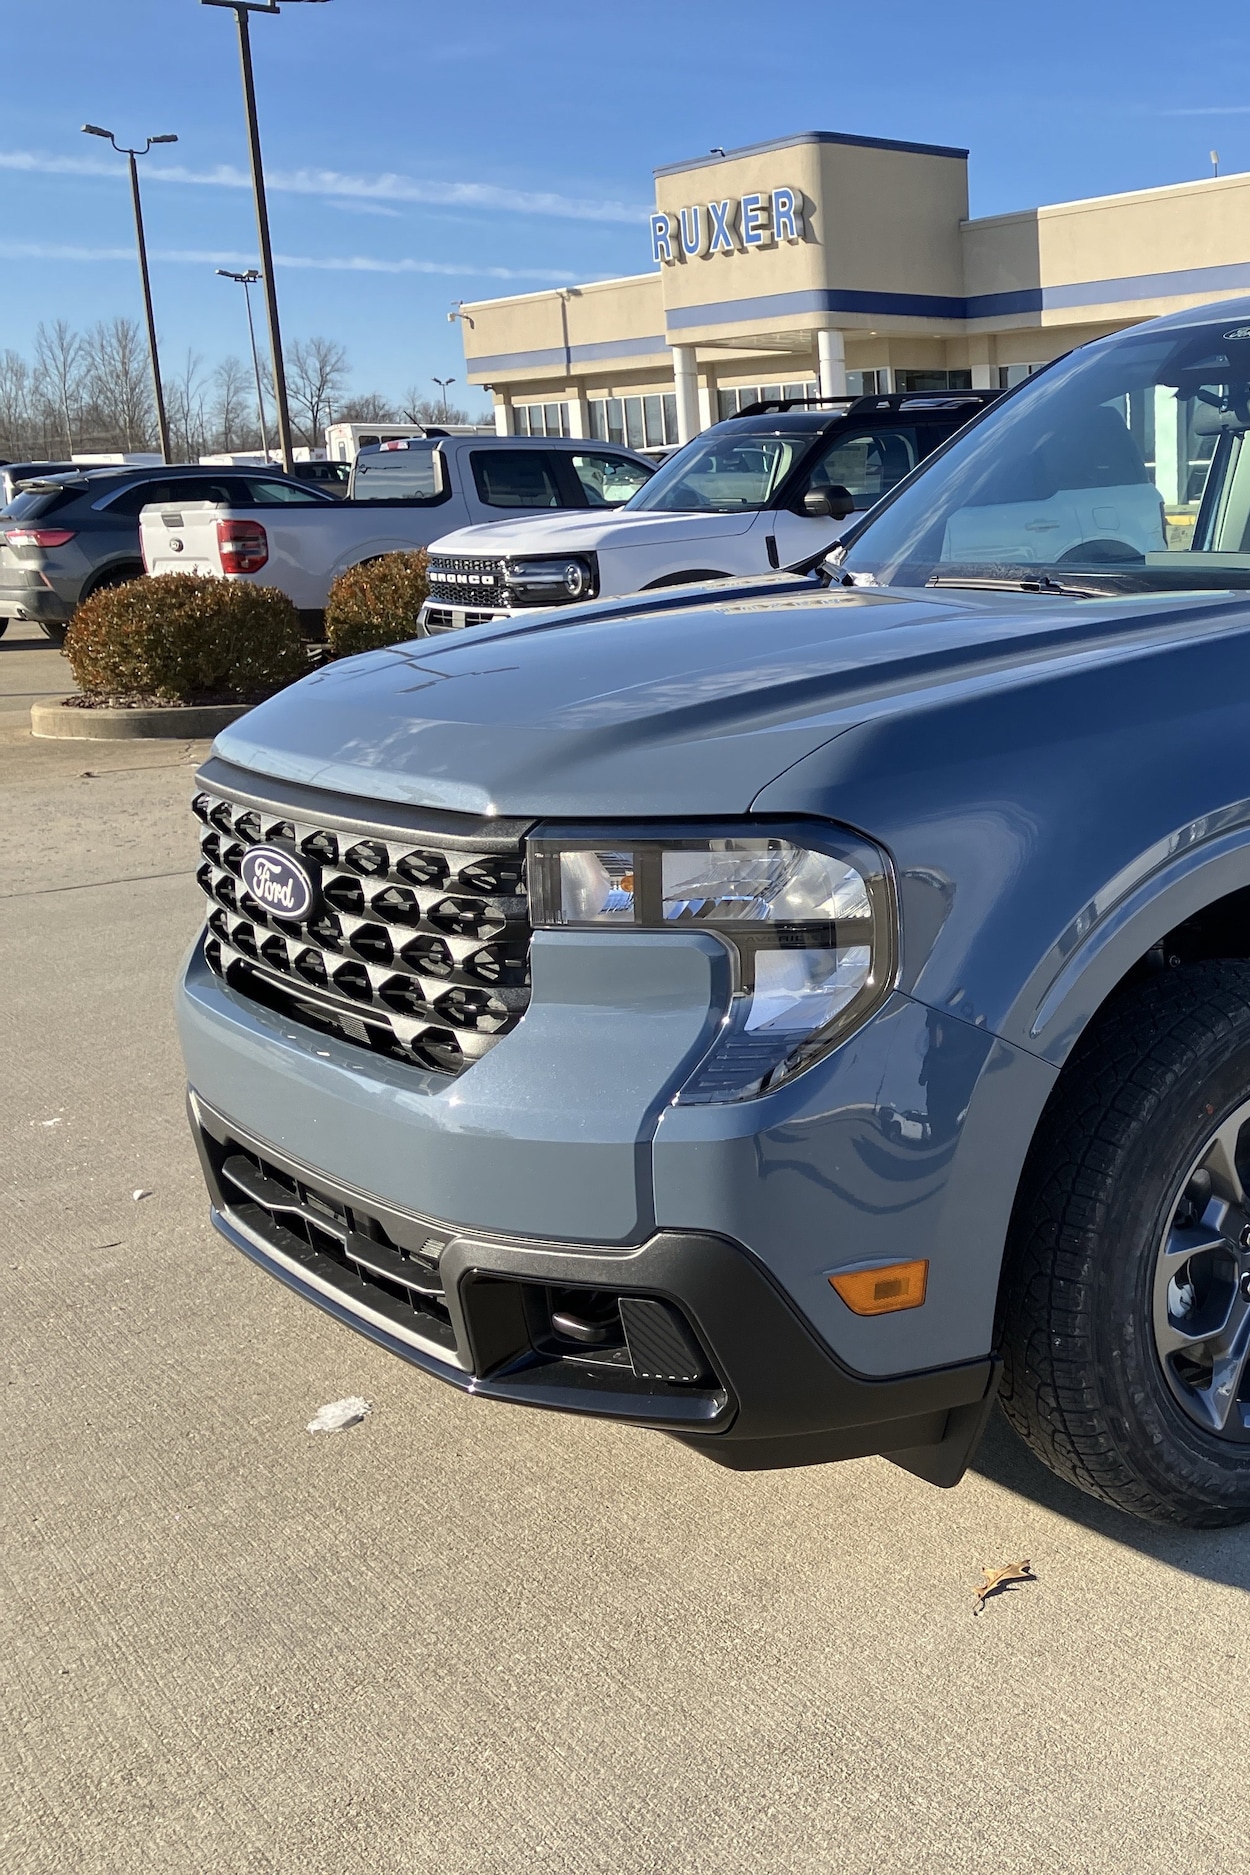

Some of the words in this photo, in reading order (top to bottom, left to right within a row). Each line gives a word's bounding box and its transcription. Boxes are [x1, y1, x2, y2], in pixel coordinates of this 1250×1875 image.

[650, 187, 804, 263] RUXER
[430, 572, 495, 585] BRONCO
[252, 857, 295, 909] Ford
